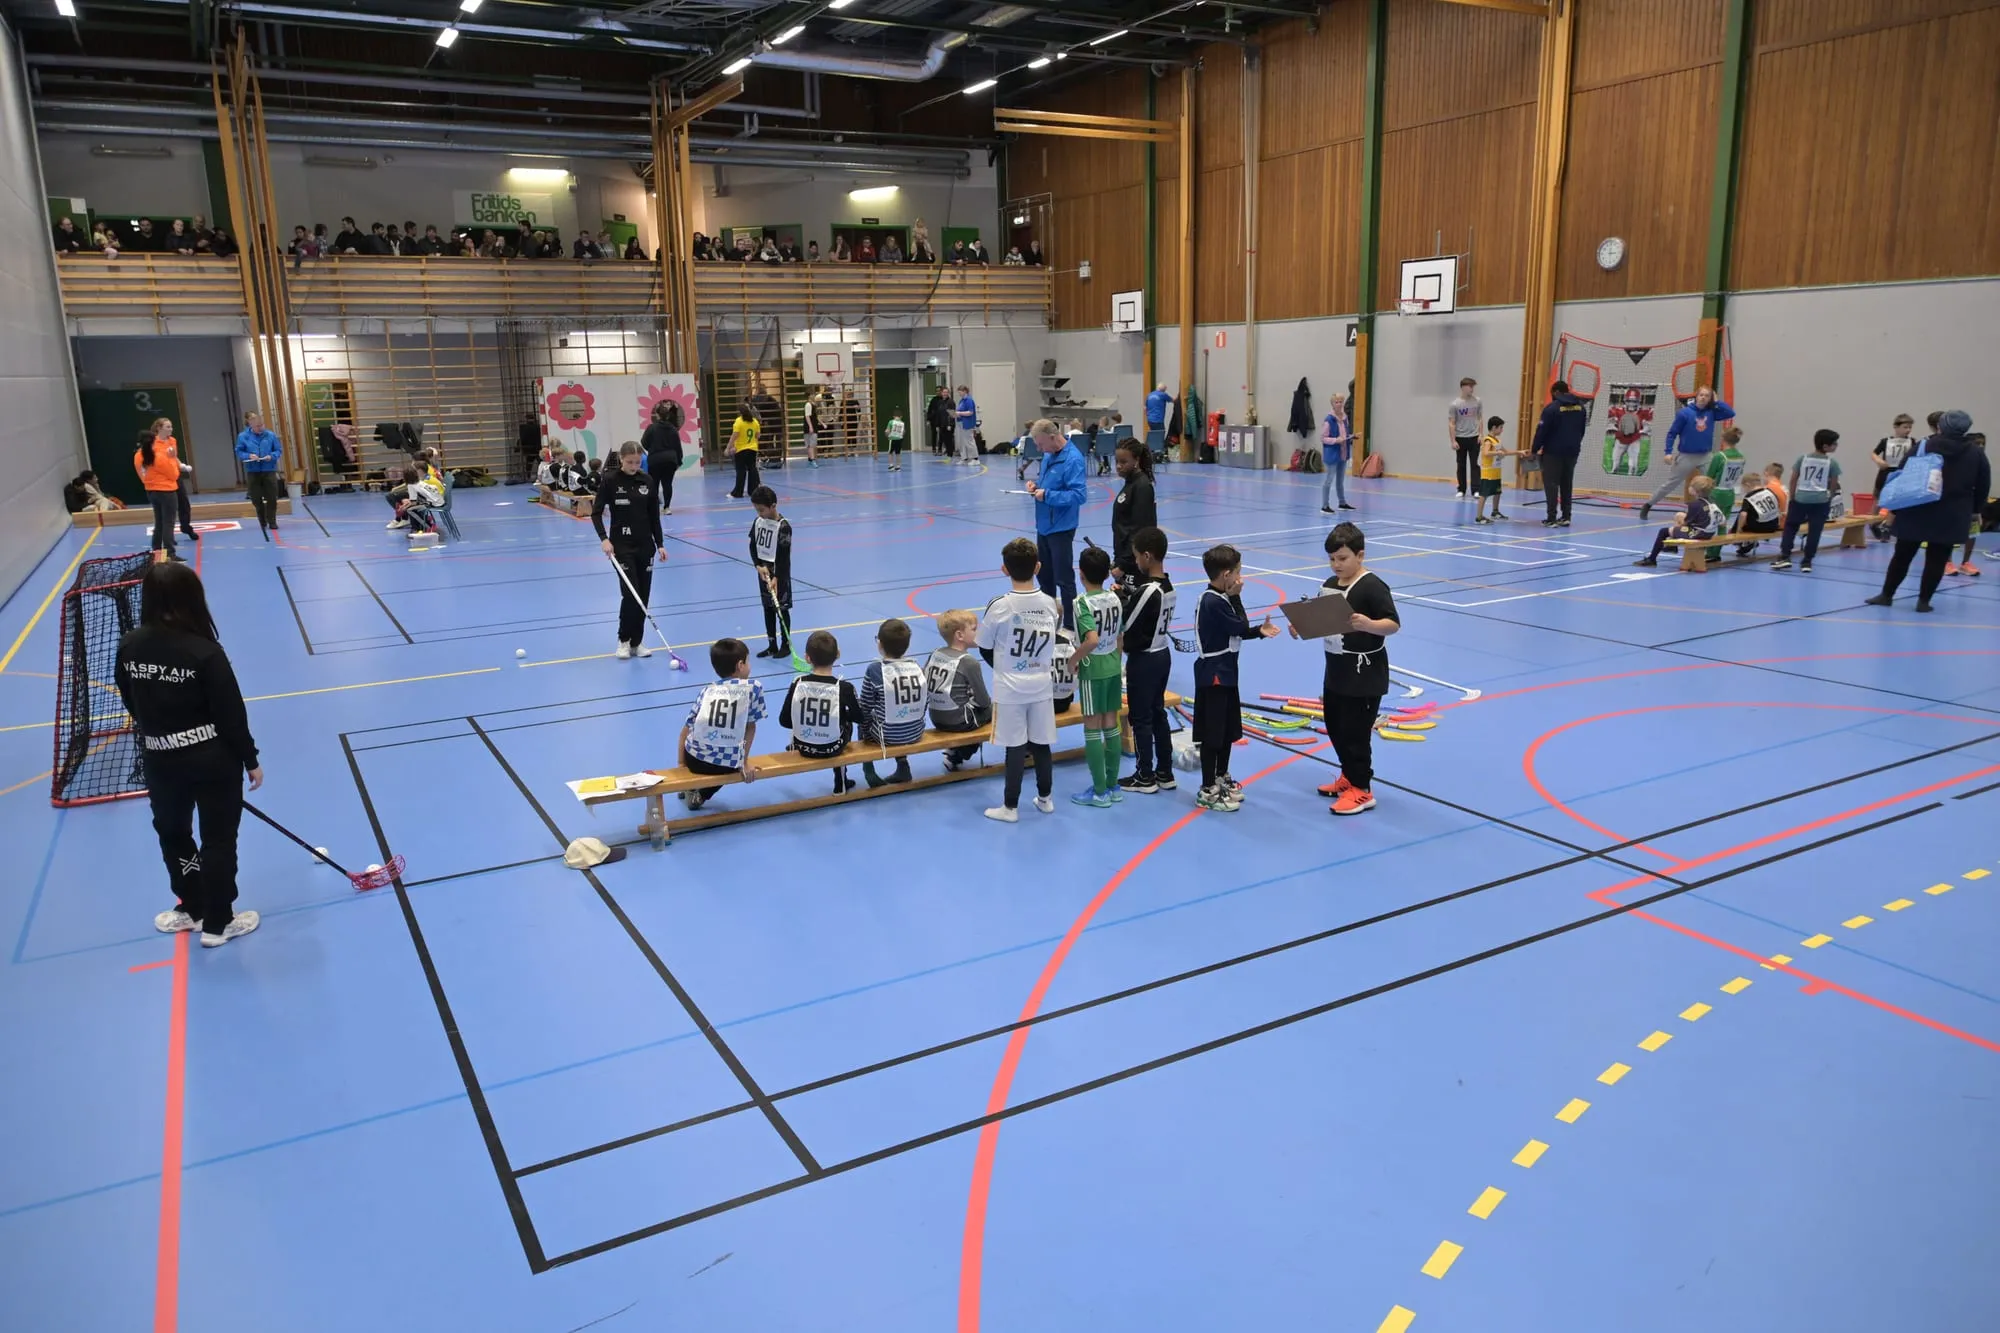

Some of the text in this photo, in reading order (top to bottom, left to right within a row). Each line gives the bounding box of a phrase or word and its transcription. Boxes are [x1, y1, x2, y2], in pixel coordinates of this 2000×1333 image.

[471, 193, 521, 211] Fritids
[472, 207, 537, 224] banken
[1348, 327, 1358, 343] A
[134, 391, 152, 411] 3
[746, 428, 754, 443] 9
[1804, 465, 1824, 482] 174
[1755, 495, 1776, 515] 318
[622, 526, 632, 536] FA
[756, 527, 774, 549] 160
[1093, 606, 1120, 637] 348
[1010, 627, 1050, 658] 347
[123, 661, 197, 679] VÄSBY AIK
[891, 675, 922, 705] 159
[708, 698, 738, 730] 161
[799, 696, 831, 728] 158
